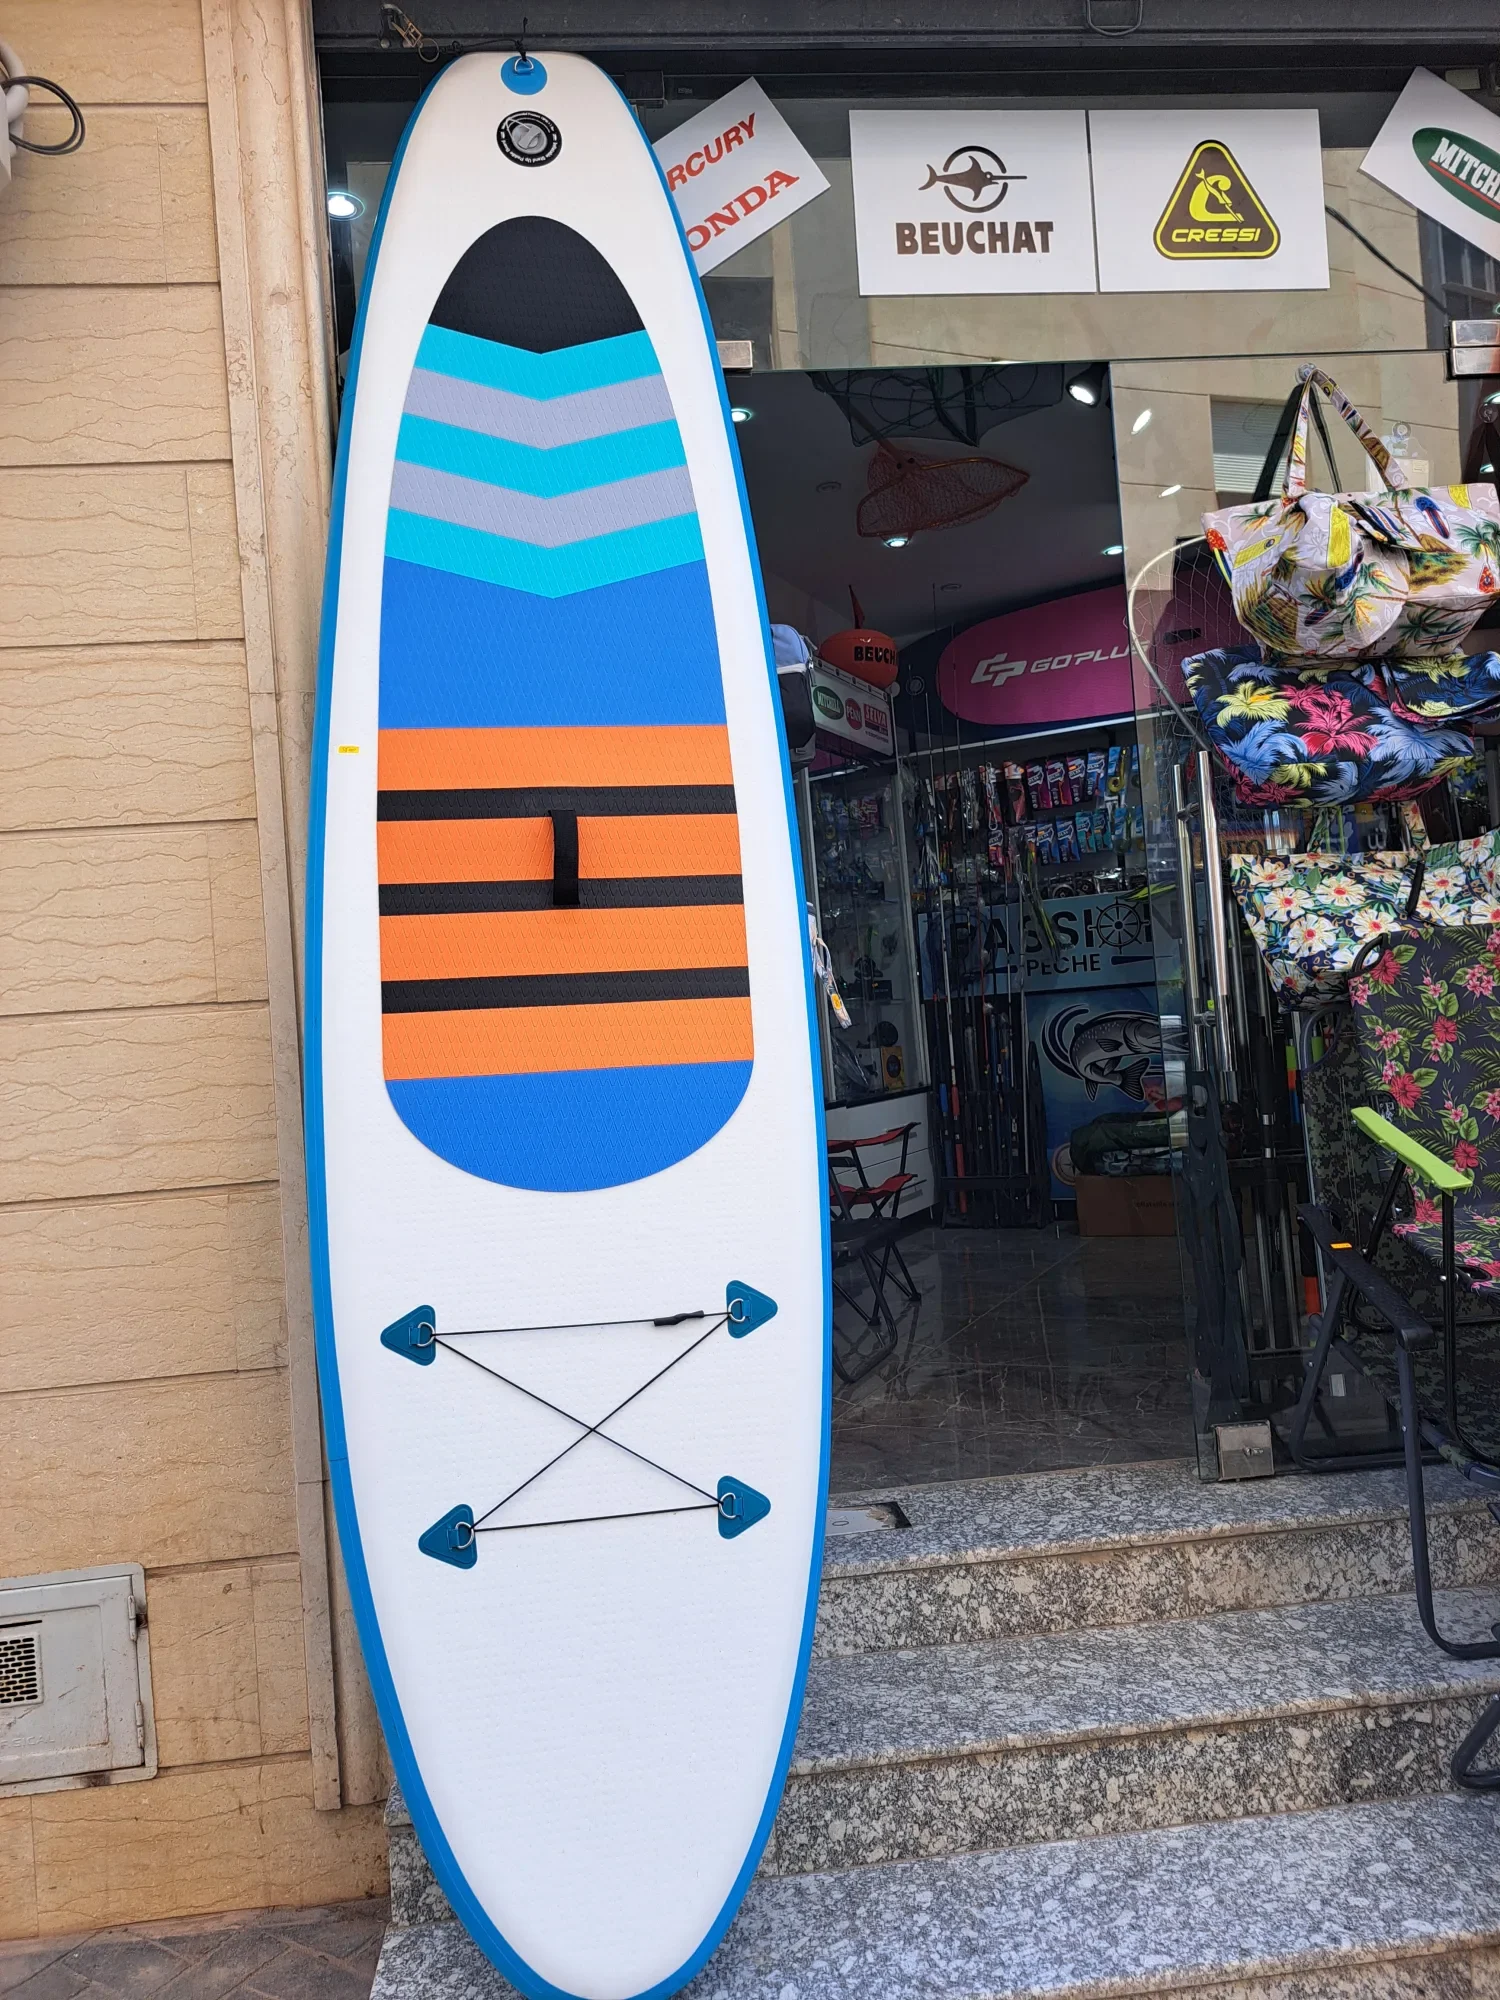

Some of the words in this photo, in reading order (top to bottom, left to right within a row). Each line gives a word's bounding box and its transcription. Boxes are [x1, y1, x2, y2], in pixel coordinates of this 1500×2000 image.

[895, 221, 1054, 255] BEUCHAT
[1171, 227, 1262, 244] CRESSI
[846, 705, 862, 723] PENN
[866, 705, 887, 727] SELVA
